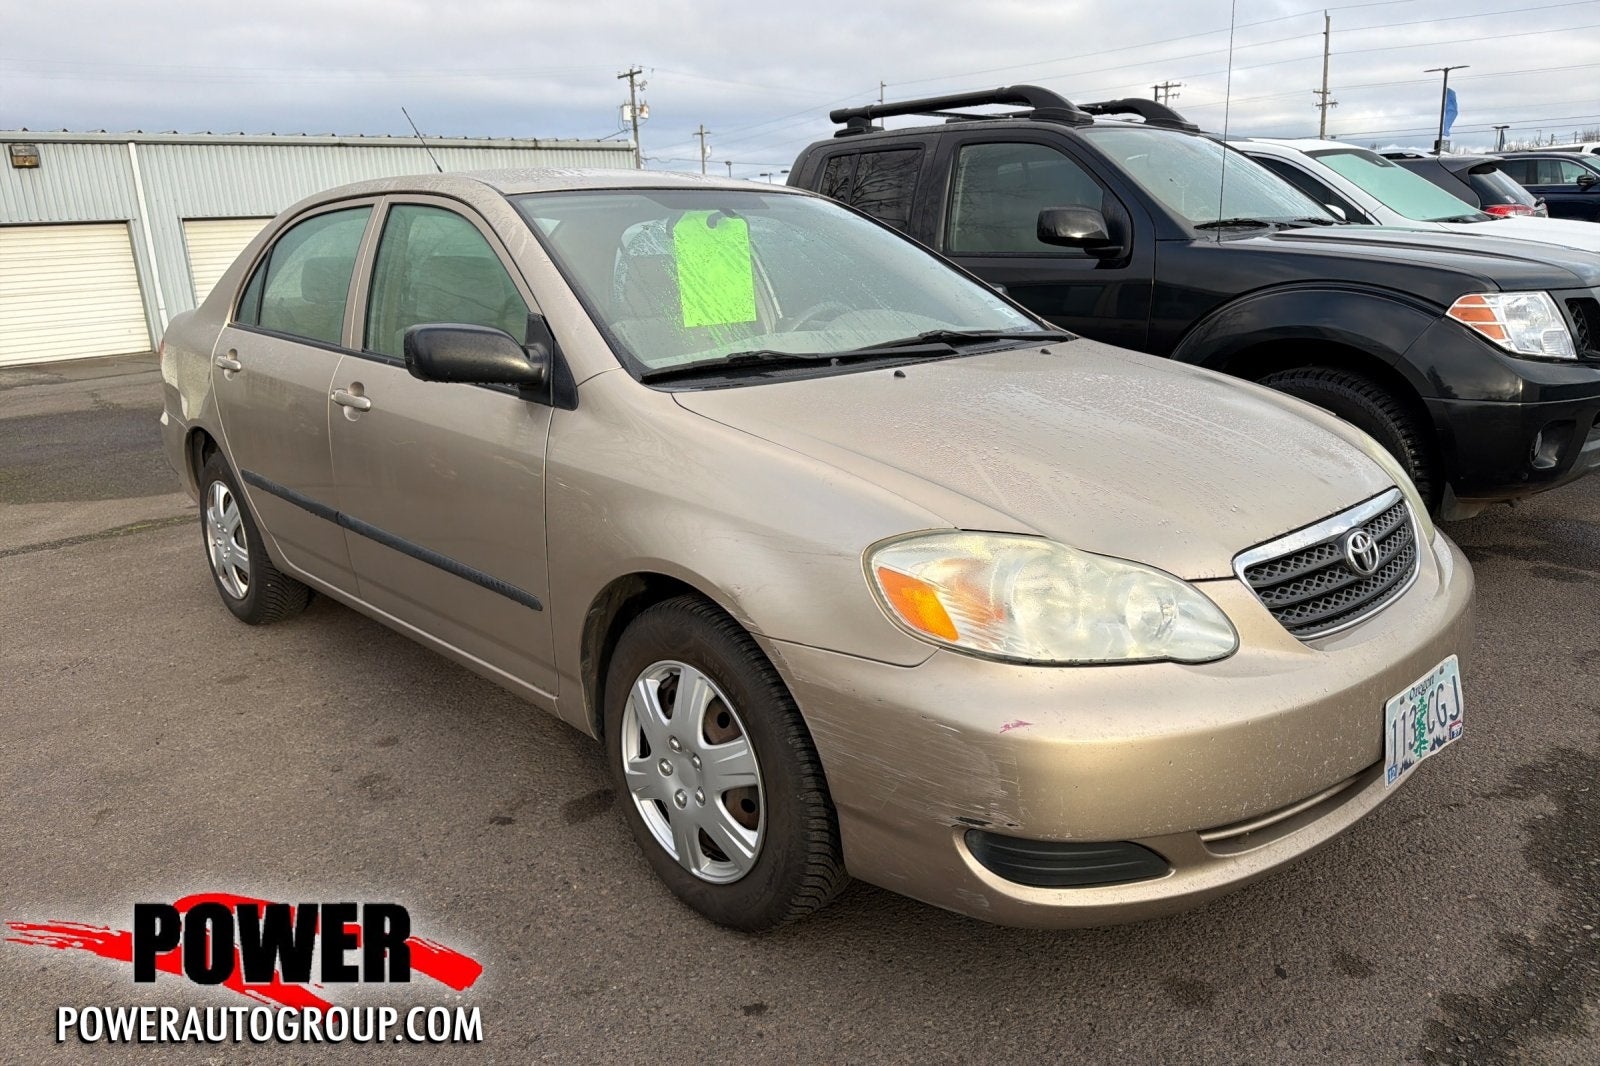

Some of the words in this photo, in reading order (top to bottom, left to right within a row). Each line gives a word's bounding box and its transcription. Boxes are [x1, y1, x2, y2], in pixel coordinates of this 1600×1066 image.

[1409, 675, 1434, 700] Oregon
[1392, 704, 1417, 765] 113
[1427, 675, 1460, 734] CGJ
